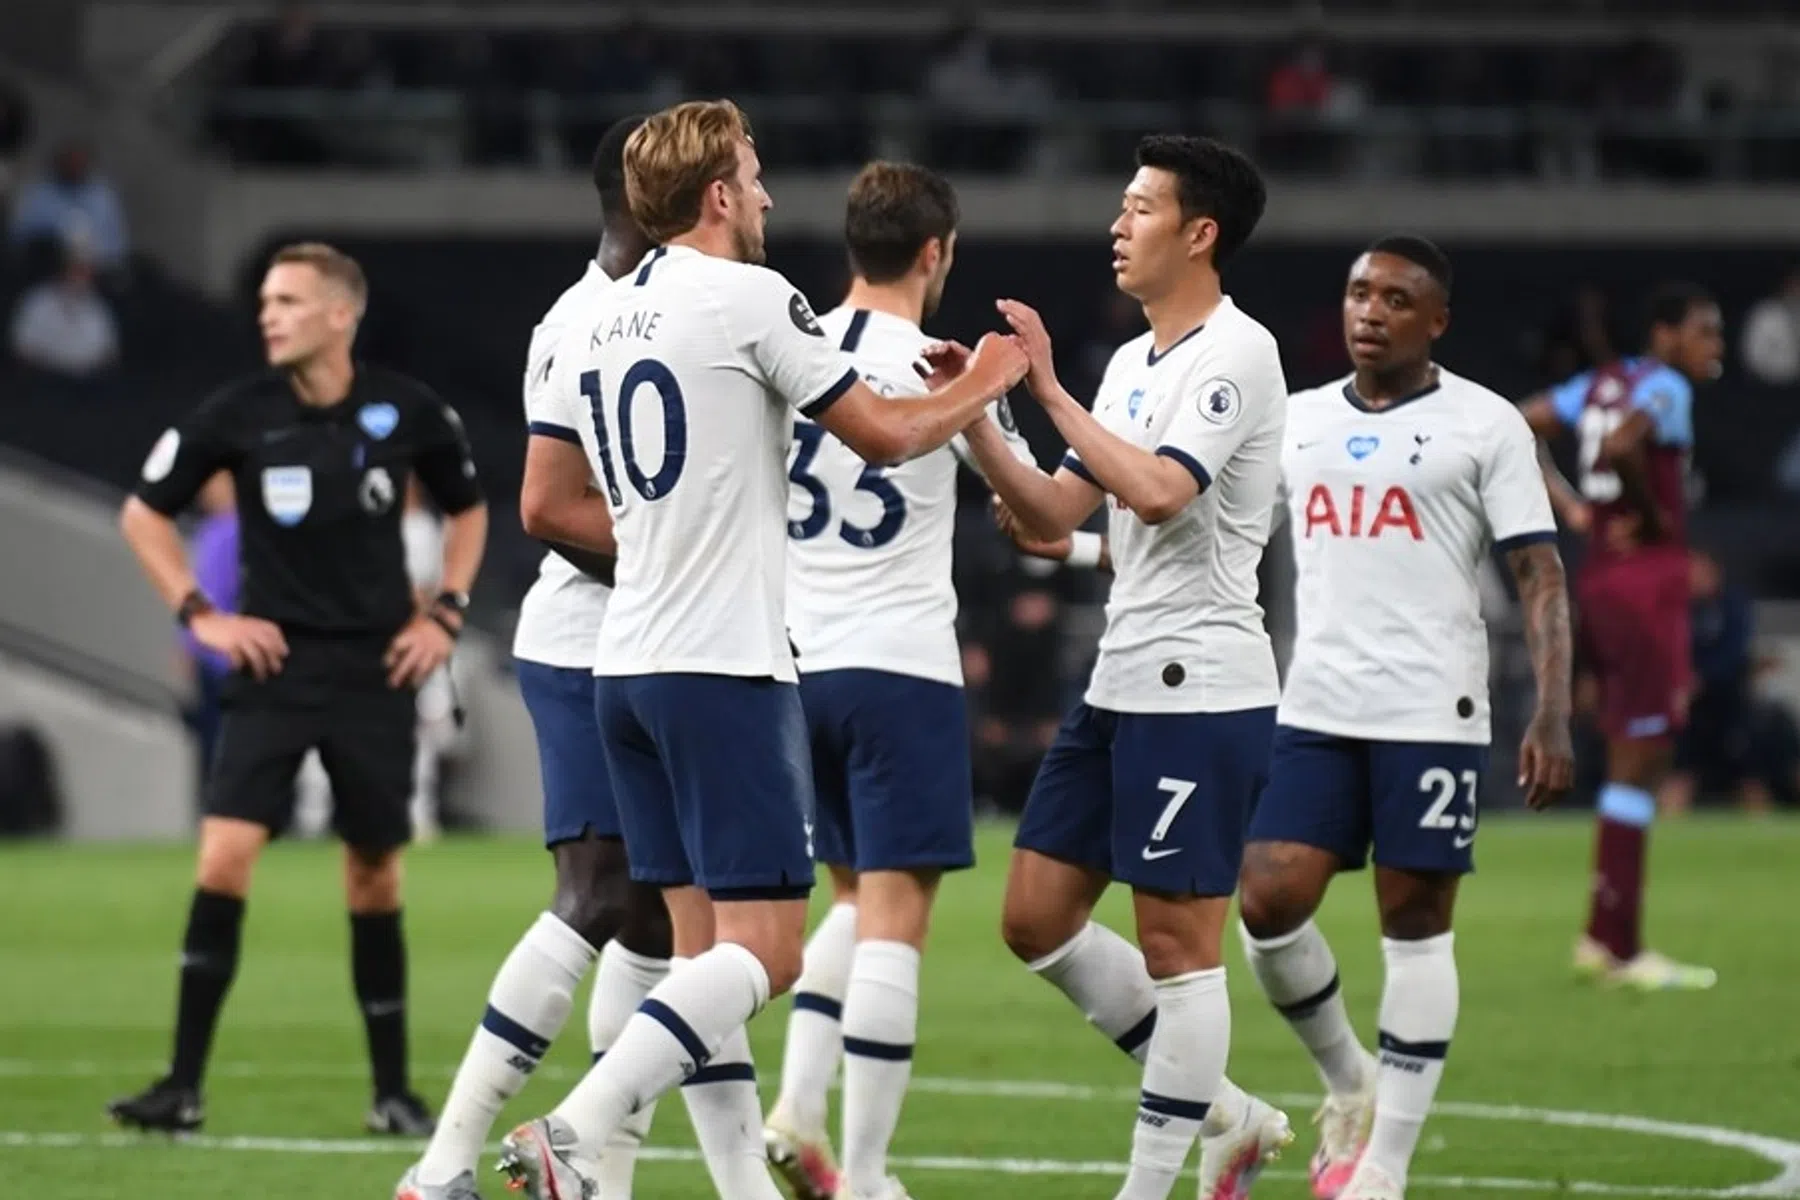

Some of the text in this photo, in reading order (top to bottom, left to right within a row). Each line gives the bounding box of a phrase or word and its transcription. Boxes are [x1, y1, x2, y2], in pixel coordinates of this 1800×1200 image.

[590, 311, 662, 351] KANE
[580, 358, 687, 507] 10
[787, 421, 907, 549] 33
[1305, 484, 1425, 541] AIA
[1150, 776, 1198, 841] 7
